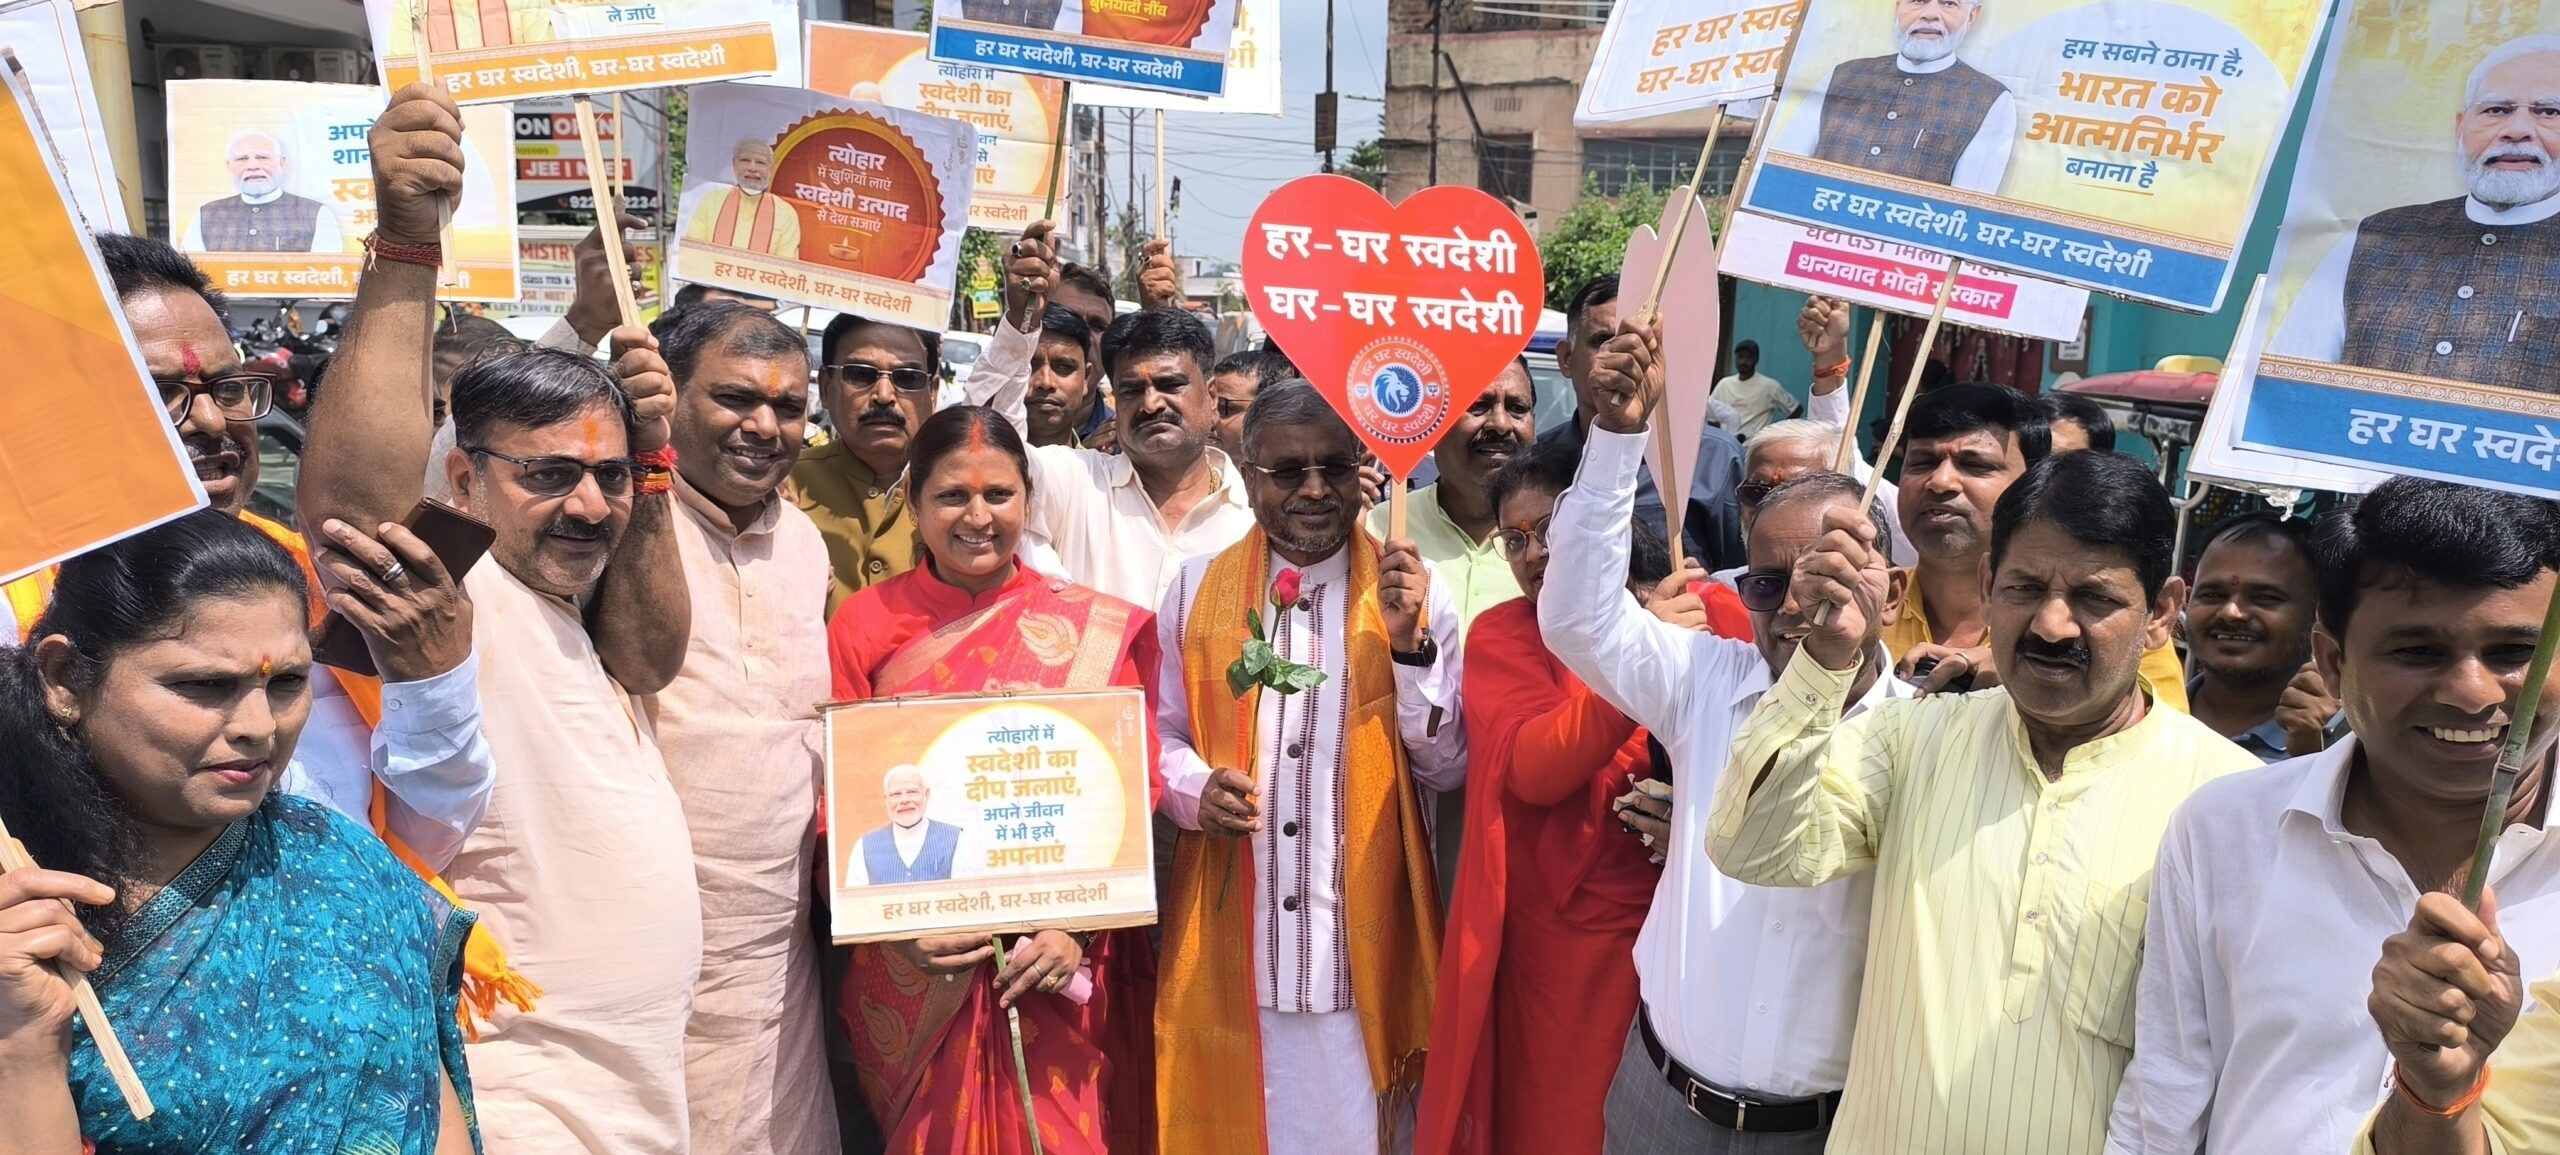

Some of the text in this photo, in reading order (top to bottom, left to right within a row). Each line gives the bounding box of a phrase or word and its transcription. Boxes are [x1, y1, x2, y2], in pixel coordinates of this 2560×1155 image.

[606, 4, 656, 23] ले जाएं
[1651, 24, 1693, 57] हर
[1694, 13, 1738, 43] घर
[445, 44, 726, 94] हर घर स्वदेशी, घर-घर स्वदेशी
[975, 39, 1184, 80] हर घर स्वदेशी, घर-घर स्वदेशी
[1636, 56, 1730, 94] घर-घर
[2062, 38, 2245, 79] हम सबने ठाना है,
[919, 81, 1012, 107] स्वदेशी का
[2057, 69, 2223, 119] भारत को
[2025, 110, 2226, 164] आत्मनिर्भर
[525, 160, 561, 177] JEE
[827, 144, 887, 171] त्योहार
[2064, 156, 2159, 189] बनाना है
[817, 166, 892, 191] में खुशियाँ लाएं
[795, 182, 910, 222] स्वदेशी उत्पाद
[984, 204, 1029, 221] स्वदेशी
[816, 209, 882, 233] से देश सजाएं
[1811, 186, 2154, 280] हर घर स्वदेशी, घर-घर स्वदेशी
[1400, 226, 1517, 275] स्वदेशी
[226, 268, 252, 287] हर
[254, 268, 279, 286] घर
[282, 264, 348, 288] स्वदेशी,
[714, 261, 913, 314] हर घर स्वदेशी, घर-घर स्वदेशी
[1797, 254, 1878, 287] धन्यवाद
[1881, 267, 1929, 296] मोदी
[1407, 288, 1524, 336] स्वदेशी
[1361, 347, 1433, 376] हर घर स्वदेशी
[1402, 403, 1437, 433] स्वदेशी
[2347, 408, 2402, 445] हर
[2407, 417, 2467, 454] घर
[987, 723, 1055, 744] त्योहारों में
[966, 745, 1078, 773] स्वदेशी का
[965, 769, 1082, 802] दीप जलाएं,
[983, 800, 1065, 822] अपने जीवन
[995, 821, 1056, 843] में भी इसे
[986, 839, 1066, 869] अपनाएं
[882, 882, 1109, 920] हर घर स्वदेशी, घर-घर स्वदेशी
